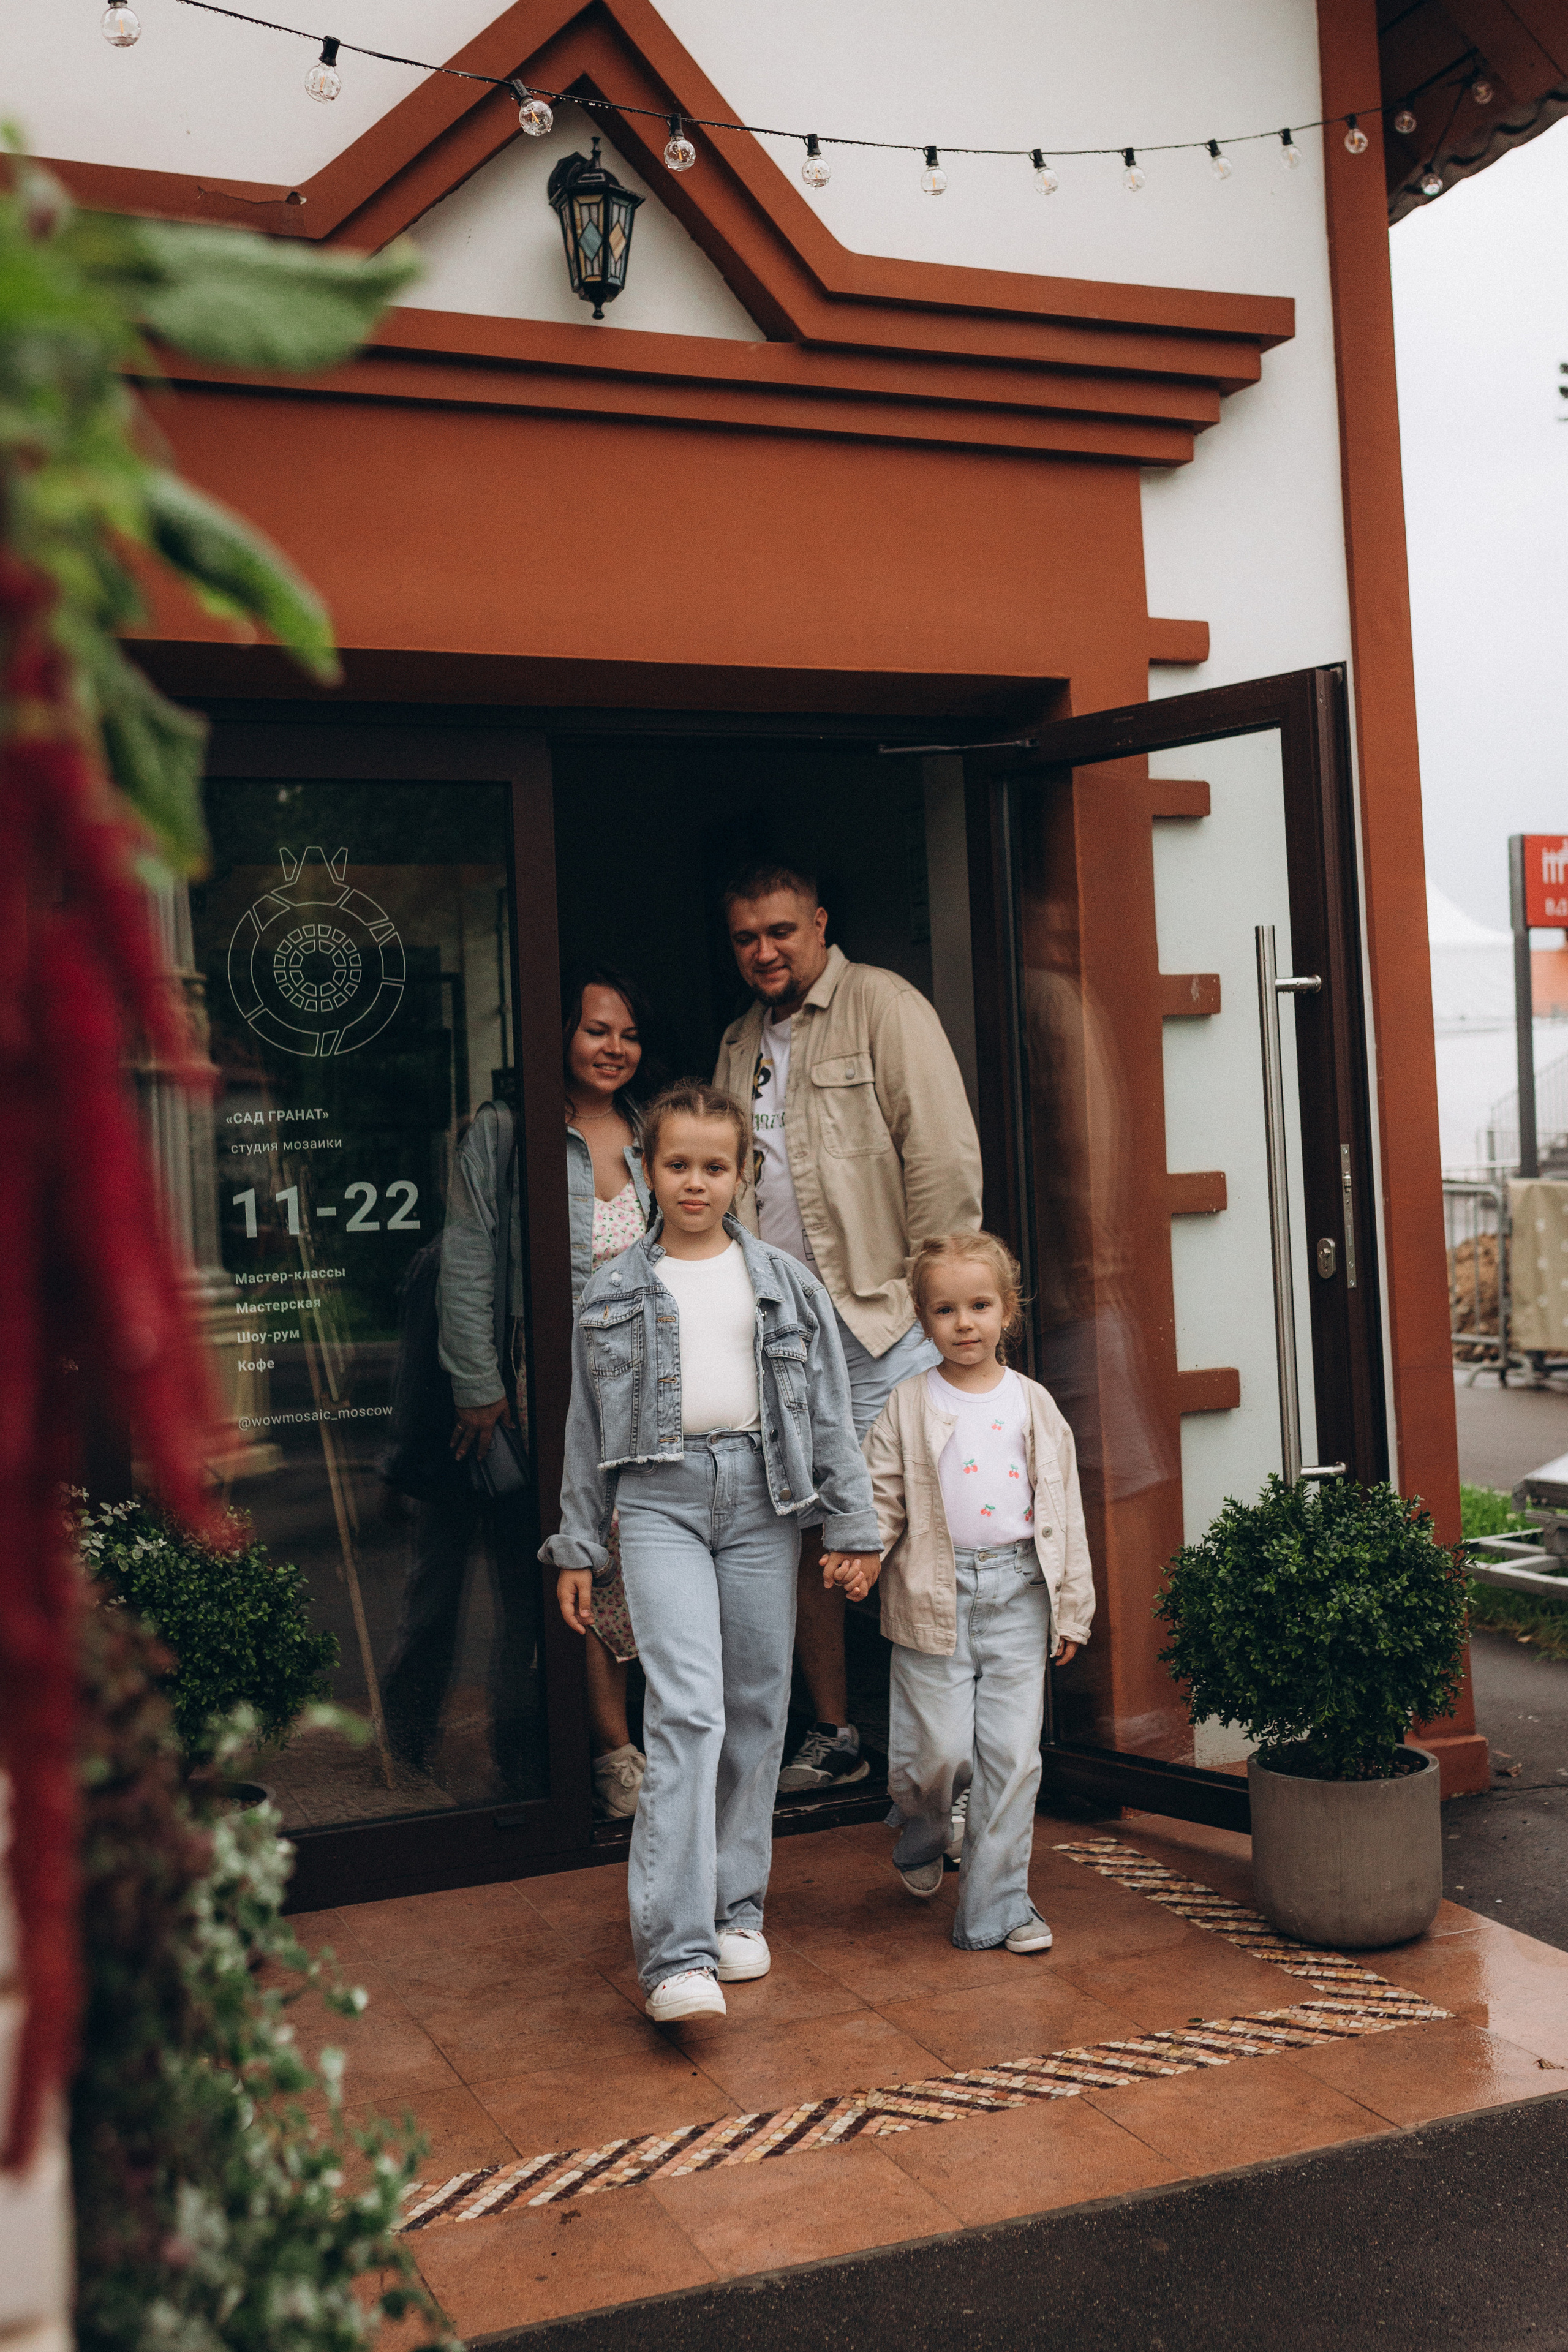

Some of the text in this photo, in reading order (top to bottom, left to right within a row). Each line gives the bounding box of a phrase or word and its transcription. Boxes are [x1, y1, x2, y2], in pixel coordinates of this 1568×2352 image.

[225, 1108, 330, 1125] «САД ГРАНАТ»
[231, 1139, 342, 1156] студия мозаики
[233, 1180, 421, 1238] 11-22
[235, 1268, 345, 1285] Мастер-классы
[236, 1298, 322, 1314] Мастерская
[237, 1330, 300, 1344] Шоу-рум
[238, 1358, 275, 1372] Кофе
[238, 1406, 393, 1431] @wowmosaic_moscow
